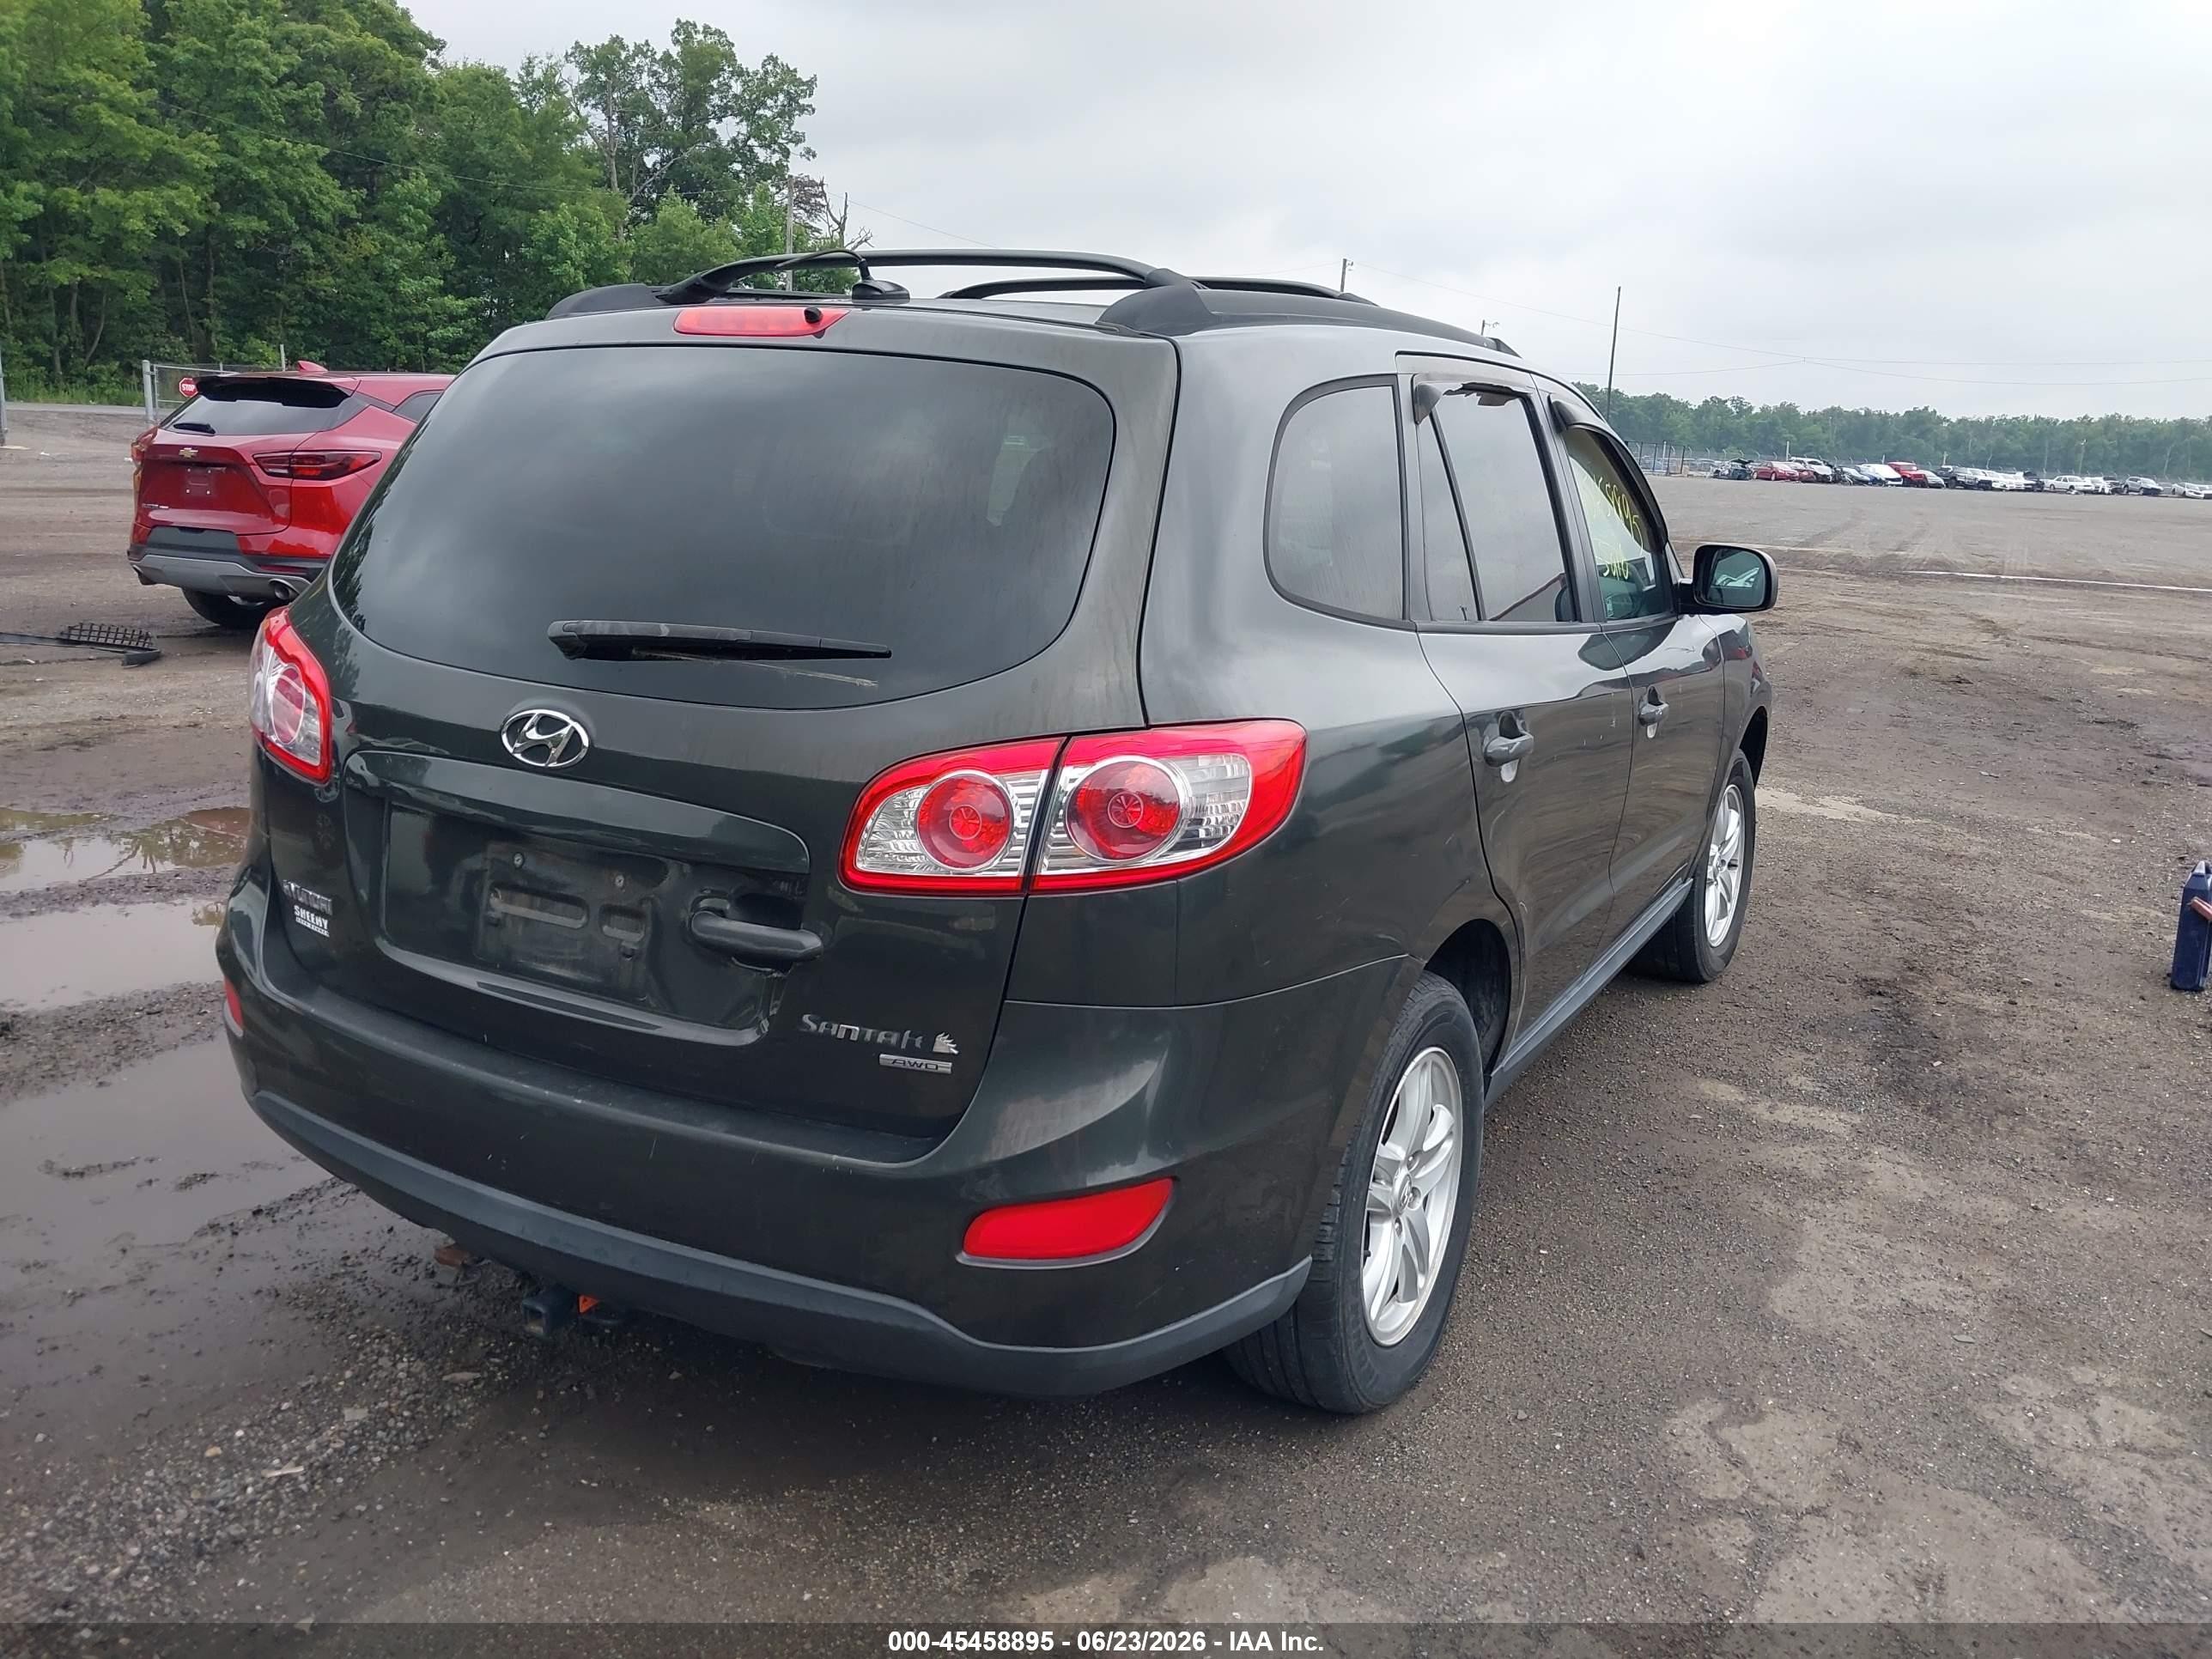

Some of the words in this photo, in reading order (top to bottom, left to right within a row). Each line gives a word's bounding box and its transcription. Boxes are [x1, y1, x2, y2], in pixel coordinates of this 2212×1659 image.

[181, 383, 196, 392] STOP
[294, 904, 329, 930] SHEEHY
[891, 1058, 939, 1071] AWD
